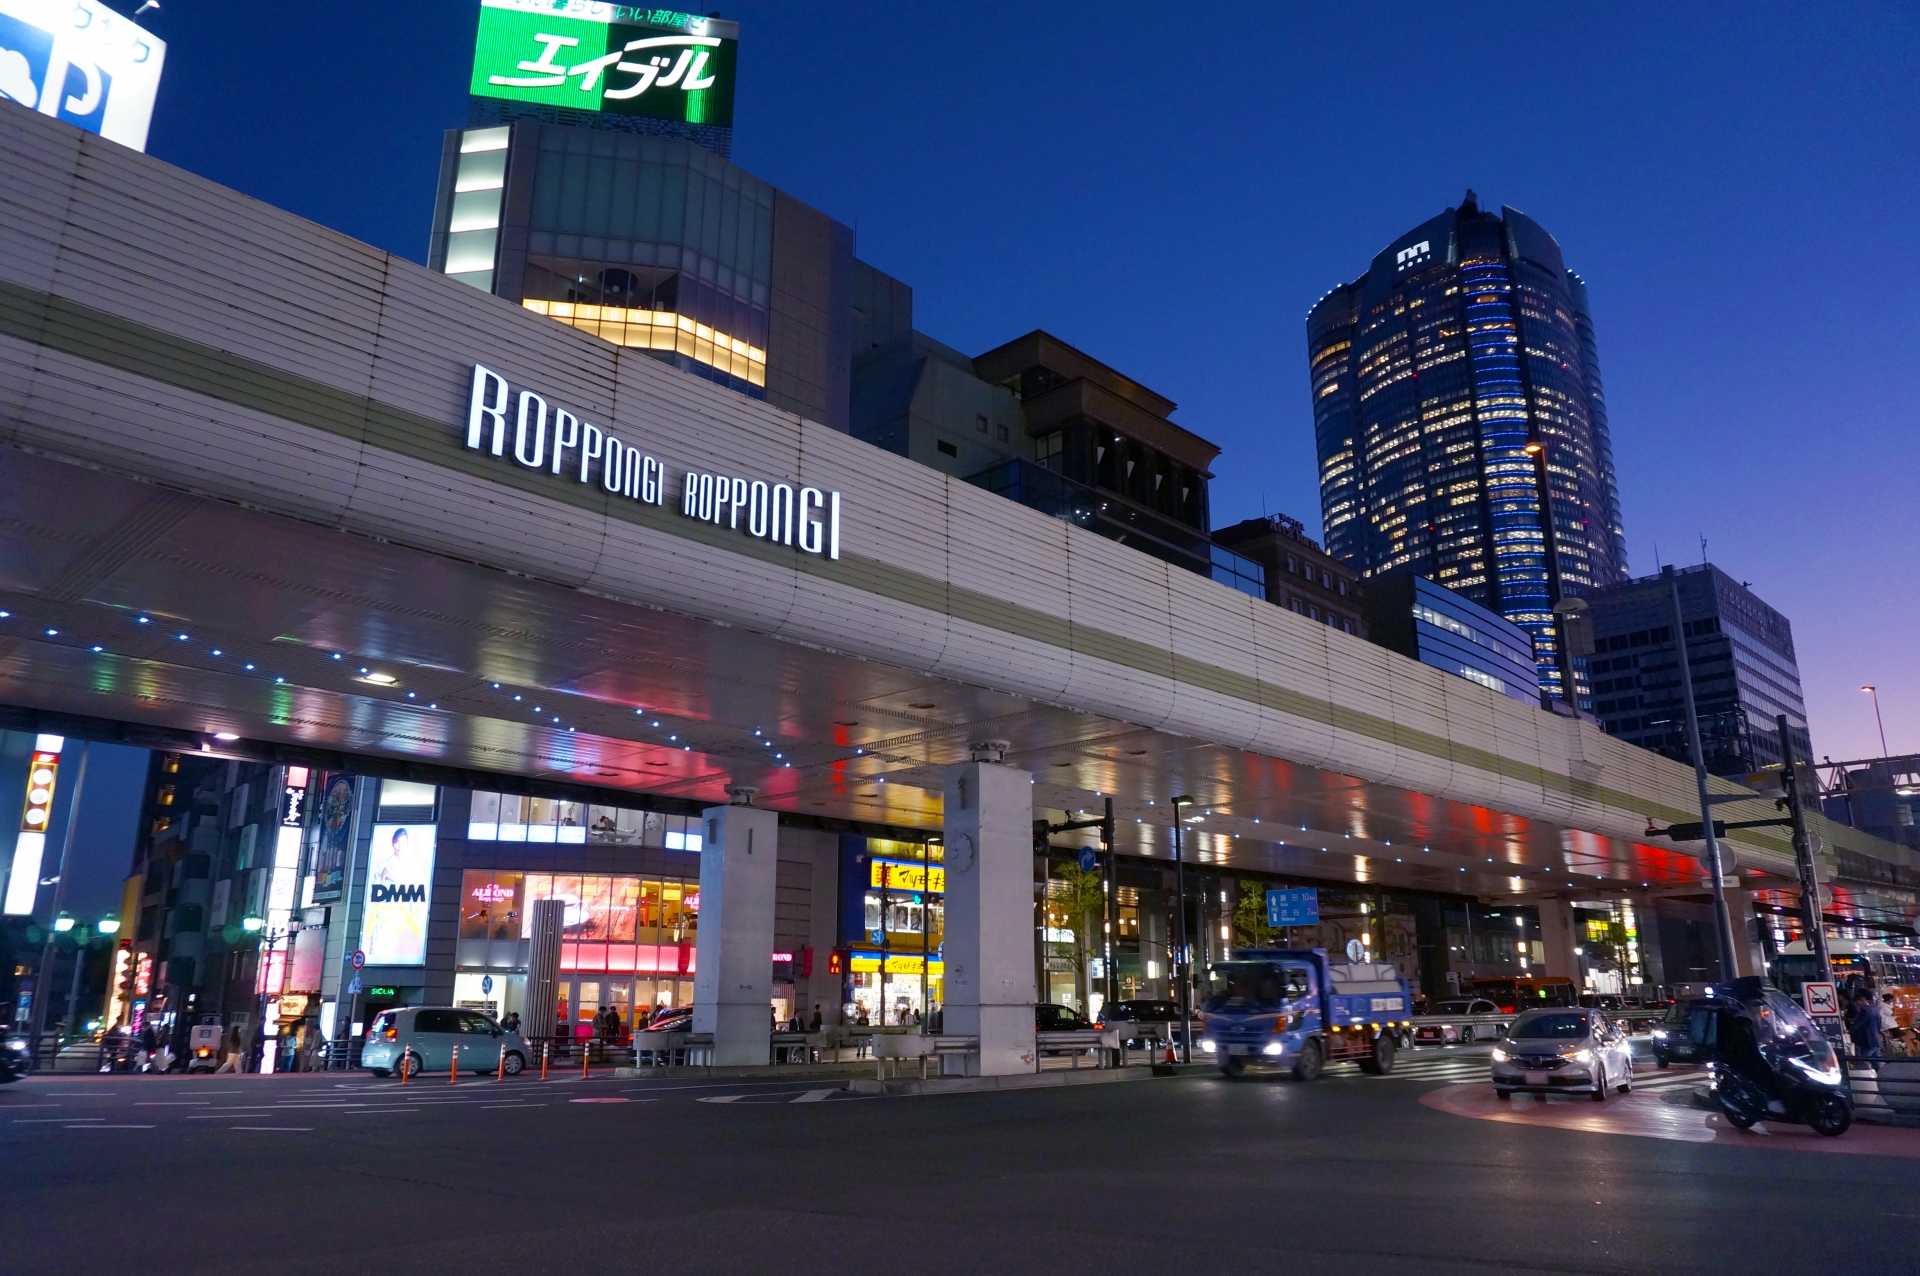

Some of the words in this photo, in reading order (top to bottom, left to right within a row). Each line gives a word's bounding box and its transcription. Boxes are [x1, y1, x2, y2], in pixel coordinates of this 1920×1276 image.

[615, 5, 706, 29] いい部屋で
[488, 33, 722, 99] エイブル
[466, 363, 665, 506] ROPPONGI
[684, 471, 842, 561] ROPPONGI
[370, 884, 425, 903] DMM
[365, 904, 424, 936] FX
